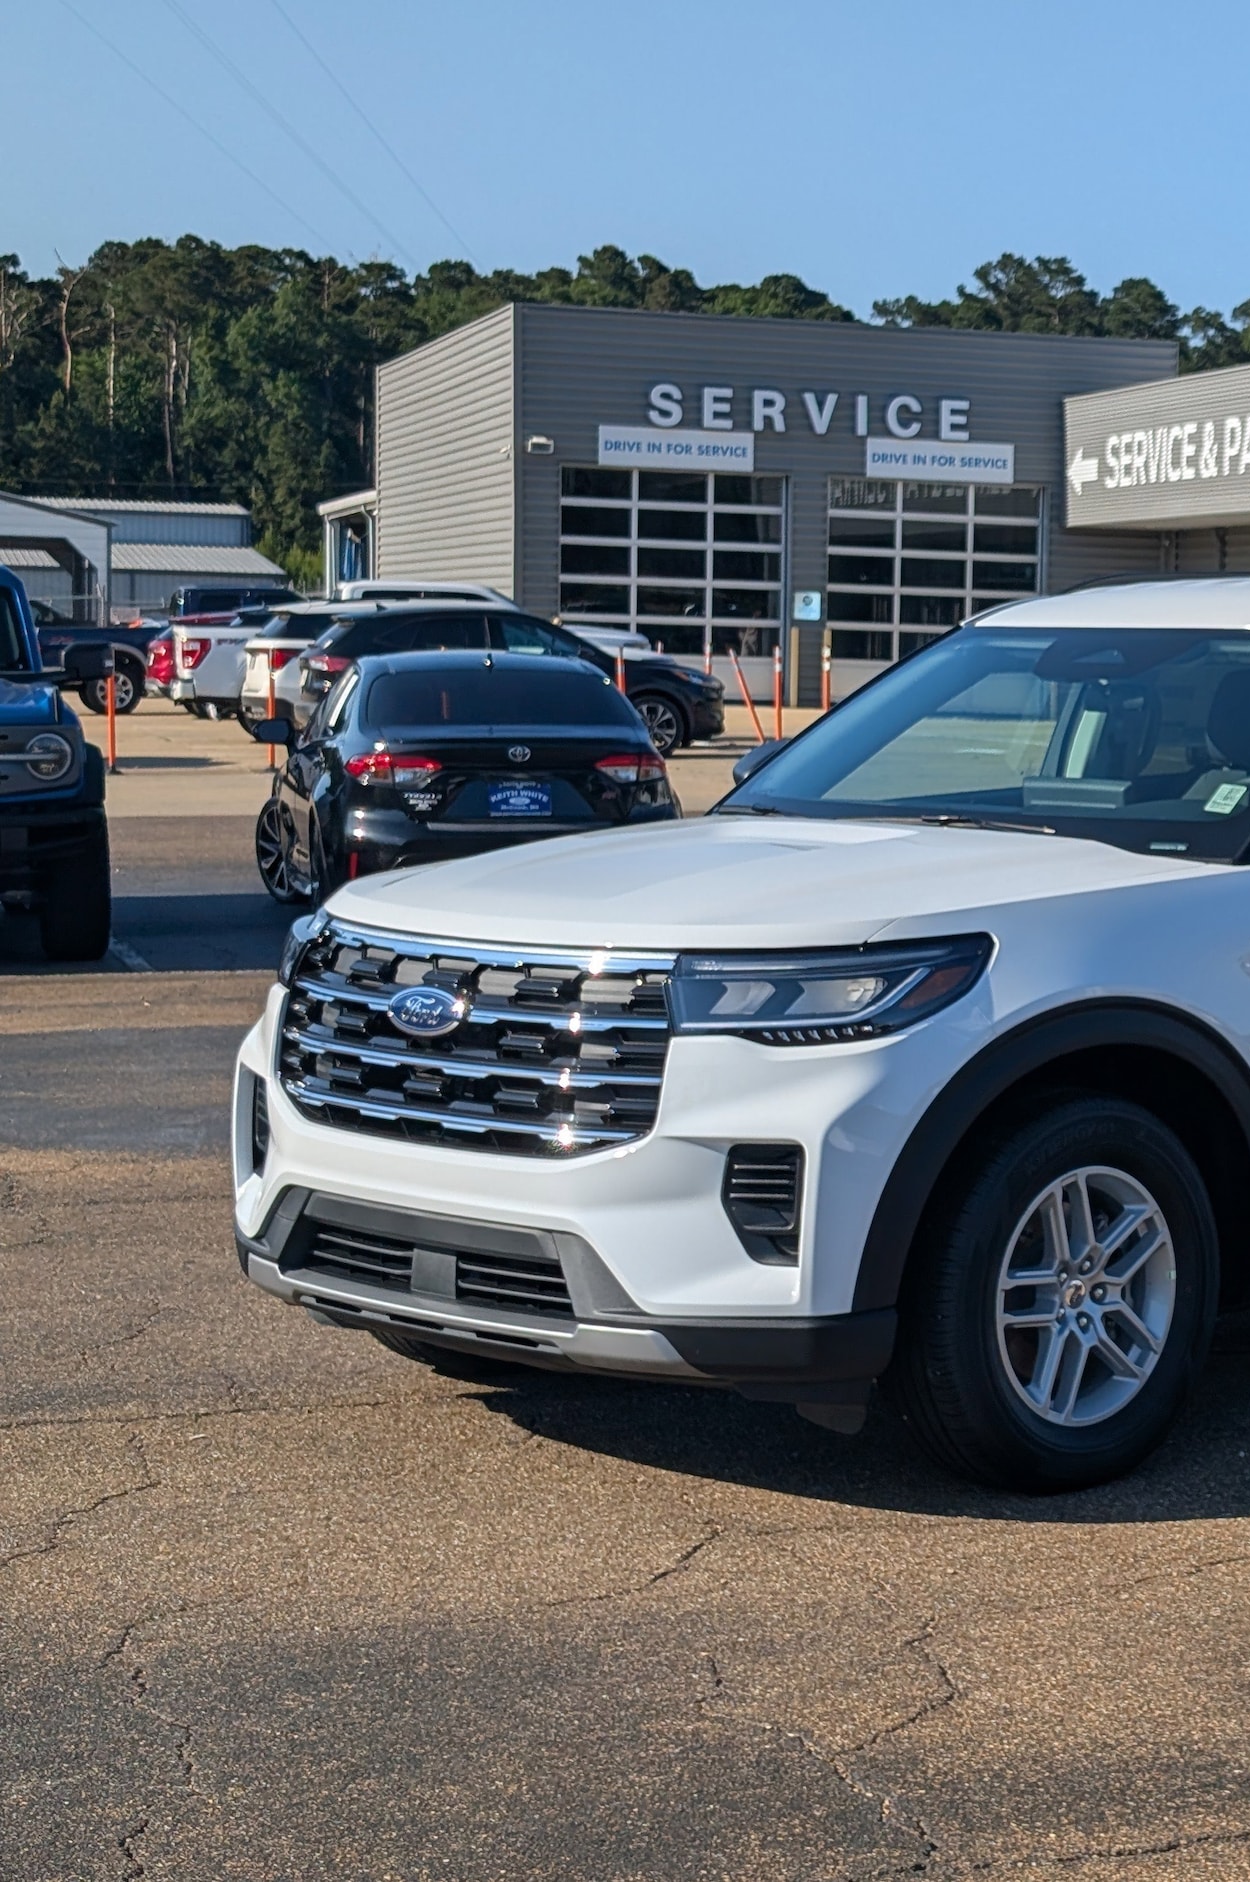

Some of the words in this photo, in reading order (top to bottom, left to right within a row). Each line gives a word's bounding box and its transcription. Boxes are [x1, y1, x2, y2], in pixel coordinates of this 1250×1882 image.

[647, 382, 971, 442] SERVICE
[604, 440, 642, 453] DRIVE
[647, 441, 662, 454] IN
[666, 442, 693, 455] FOR
[697, 444, 748, 458] SERVICE
[872, 452, 908, 465] DRIVE
[912, 454, 927, 466] IN
[931, 455, 956, 467] FOR
[959, 456, 1009, 470] SERVICE
[1103, 422, 1197, 490] SERVICE
[1199, 420, 1219, 479] &
[490, 790, 518, 803] KEITH
[519, 789, 549, 803] WHITE
[401, 995, 443, 1025] Ford
